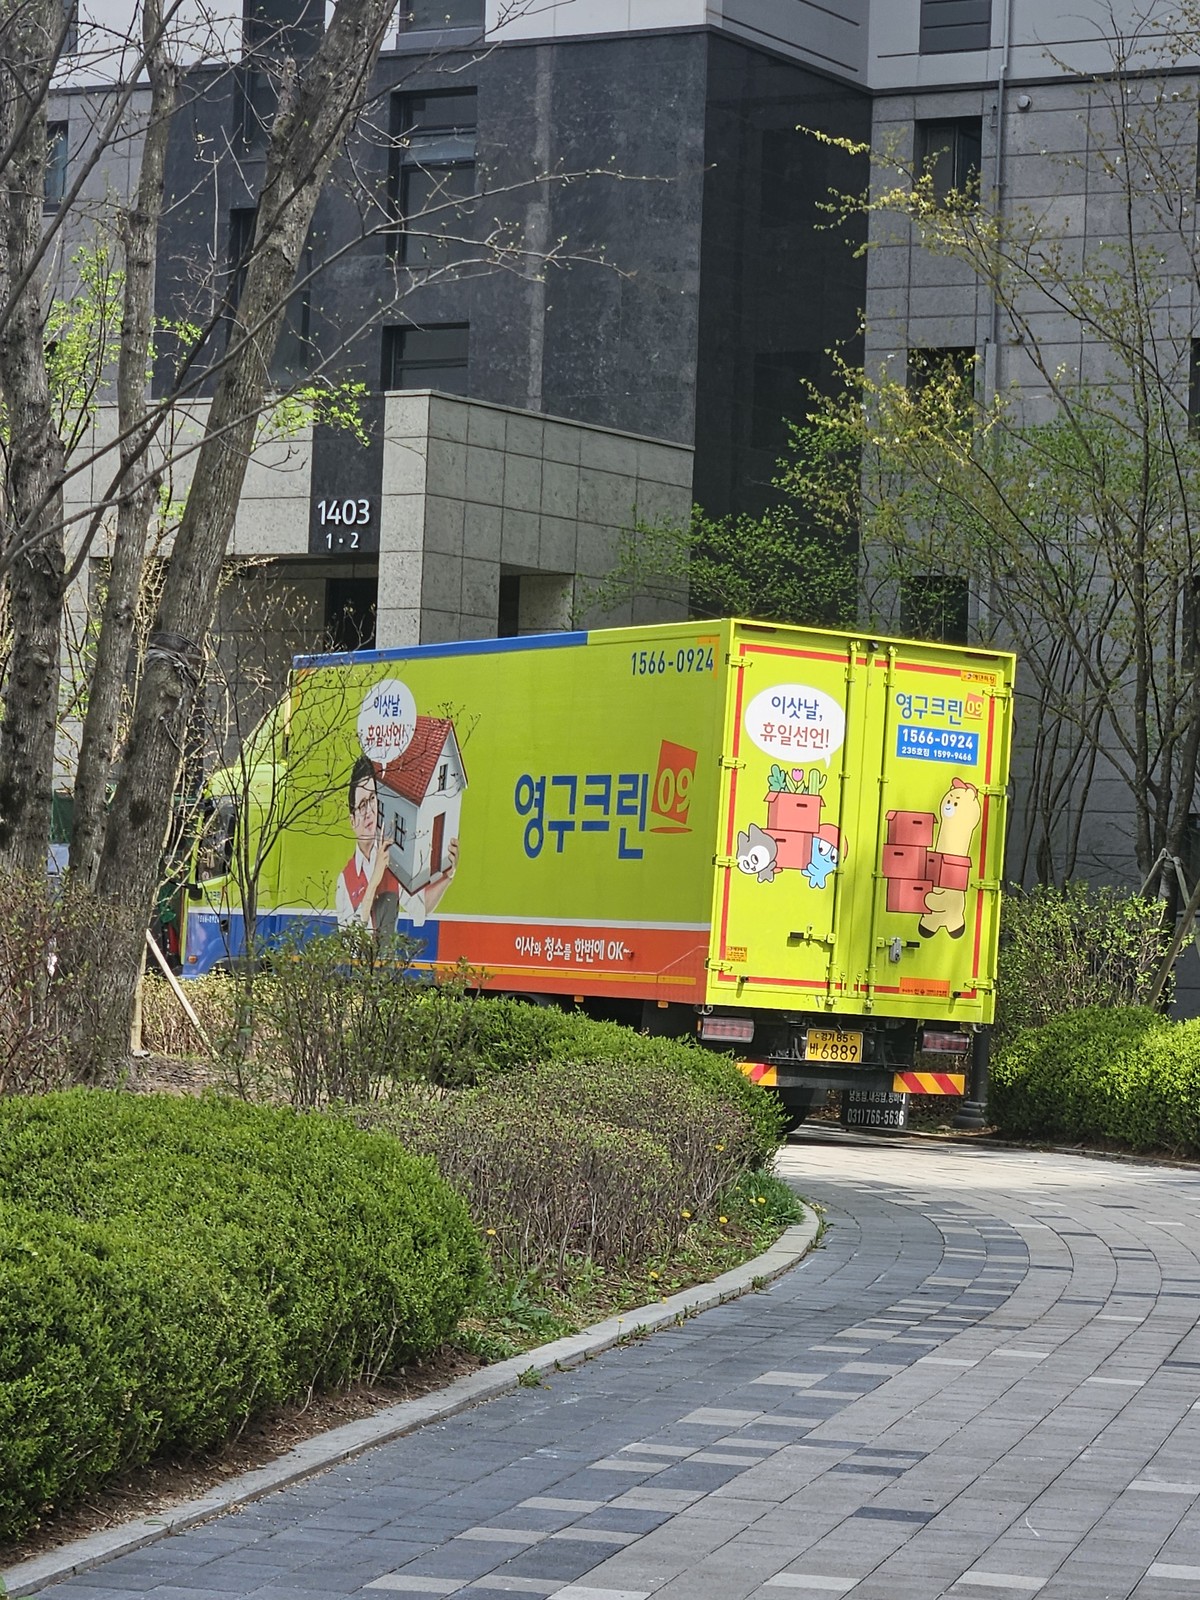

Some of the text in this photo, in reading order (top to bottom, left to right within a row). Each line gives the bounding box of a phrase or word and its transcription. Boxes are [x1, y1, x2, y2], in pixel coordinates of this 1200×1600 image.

[317, 499, 370, 526] 1403
[631, 647, 714, 676] 1566-0924
[771, 694, 823, 722] 이삿날,
[896, 693, 963, 726] 영구크린
[760, 721, 830, 750] 휴일선언!
[902, 727, 974, 751] 1566-0924
[933, 749, 972, 761] 1599-9466
[514, 773, 649, 860] 영구크린
[514, 936, 542, 958] 이사와
[543, 937, 572, 962] 청소를
[574, 938, 605, 963] 한번에
[820, 1032, 849, 1043] 경기 85
[809, 1042, 858, 1062] 바 6889
